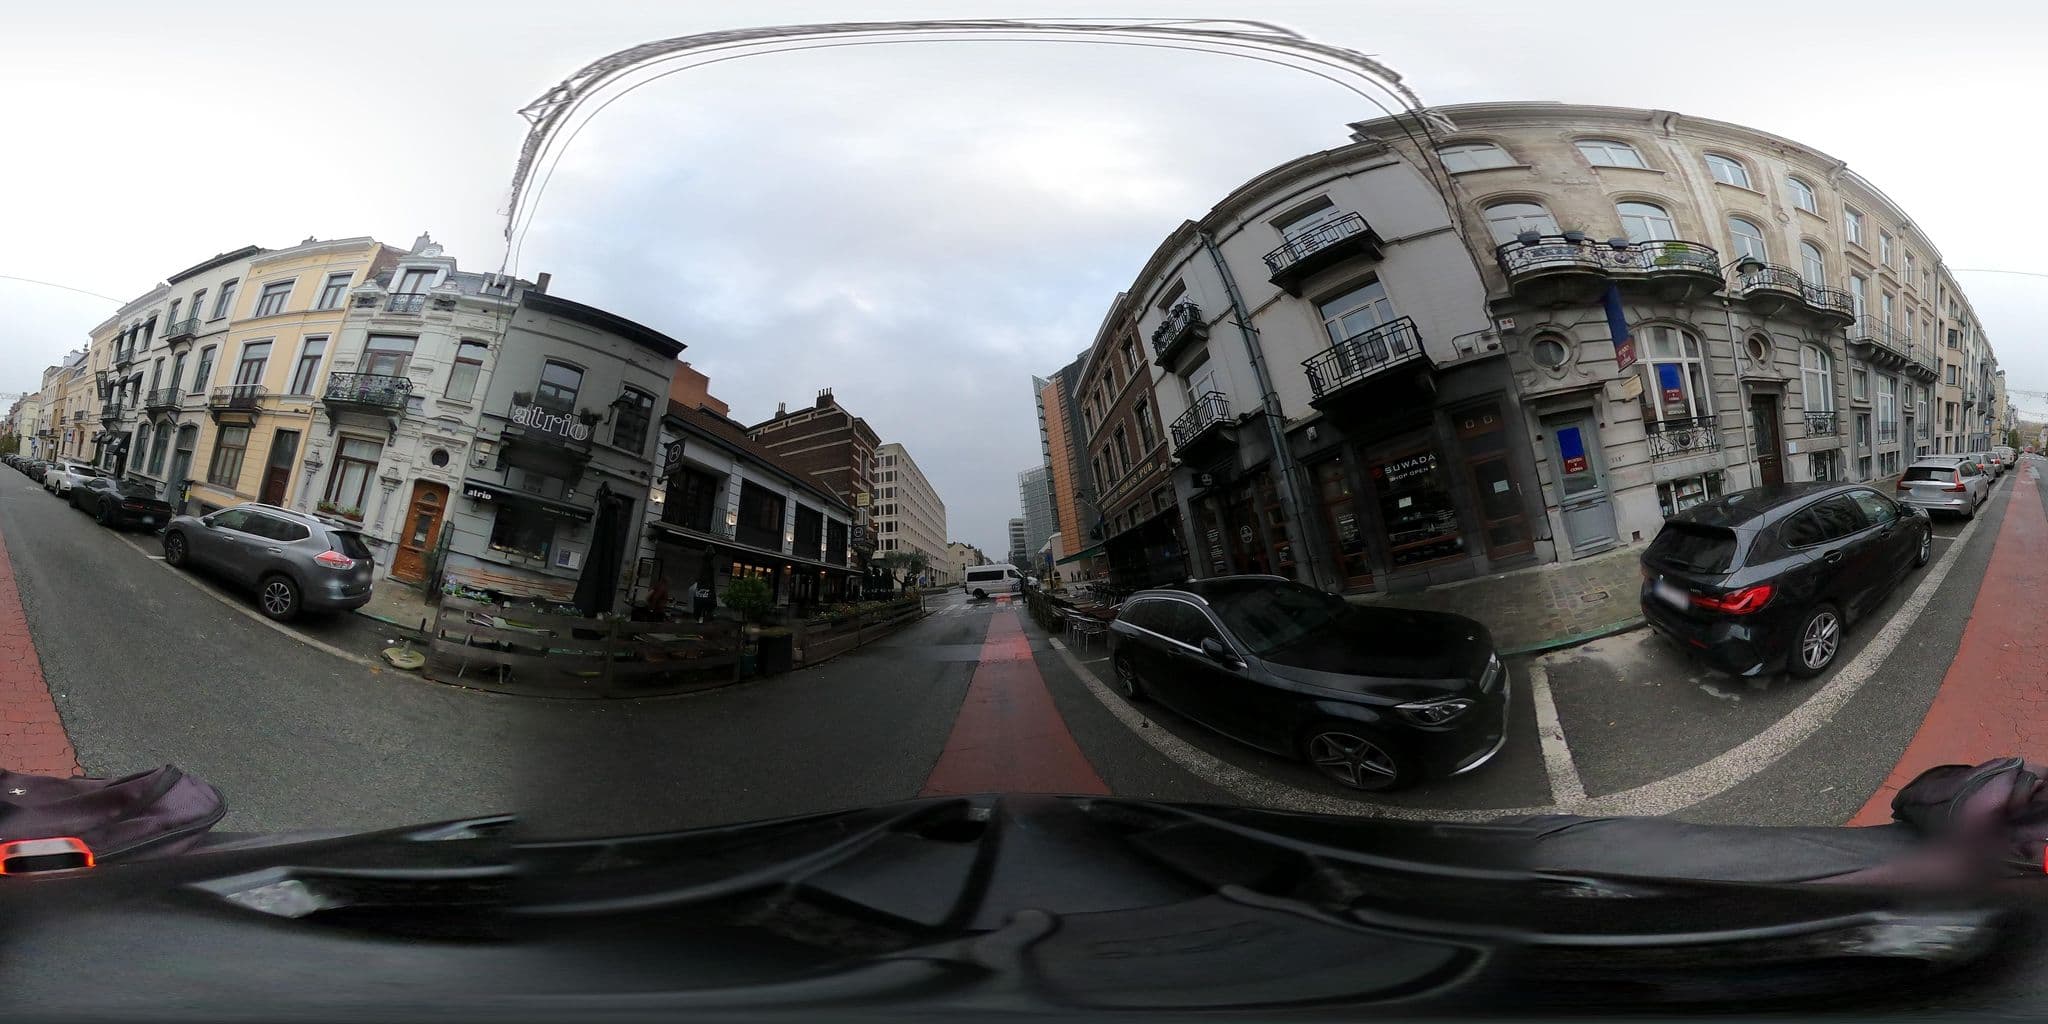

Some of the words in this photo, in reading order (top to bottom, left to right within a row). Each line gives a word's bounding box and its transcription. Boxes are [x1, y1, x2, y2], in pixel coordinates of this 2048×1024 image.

[512, 406, 588, 441] atrio
[1138, 462, 1153, 478] PUB
[1384, 453, 1436, 474] SUWADA
[1409, 467, 1429, 476] OPEN
[467, 489, 492, 500] atrio
